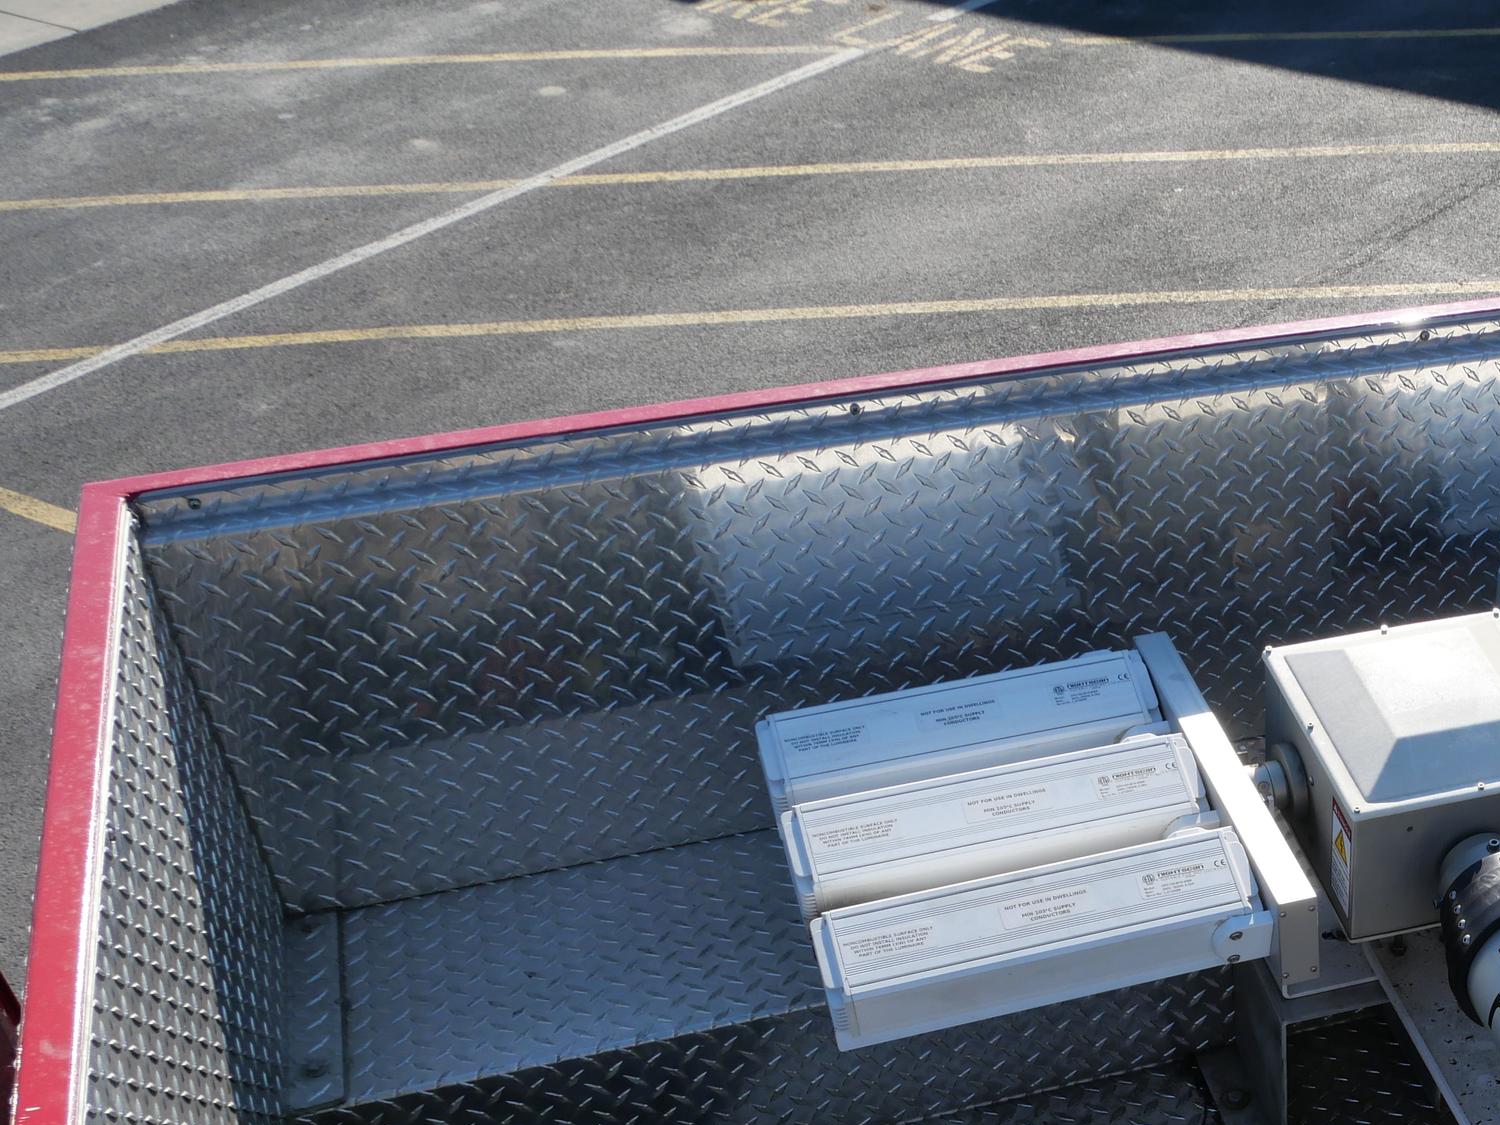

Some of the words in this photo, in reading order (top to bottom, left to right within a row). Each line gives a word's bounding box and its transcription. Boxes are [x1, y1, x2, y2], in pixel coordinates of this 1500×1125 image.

[1053, 890, 1086, 900] DWELLINGS
[1053, 903, 1076, 911] SUPPLY
[1031, 909, 1070, 921] CONDUCTORS
